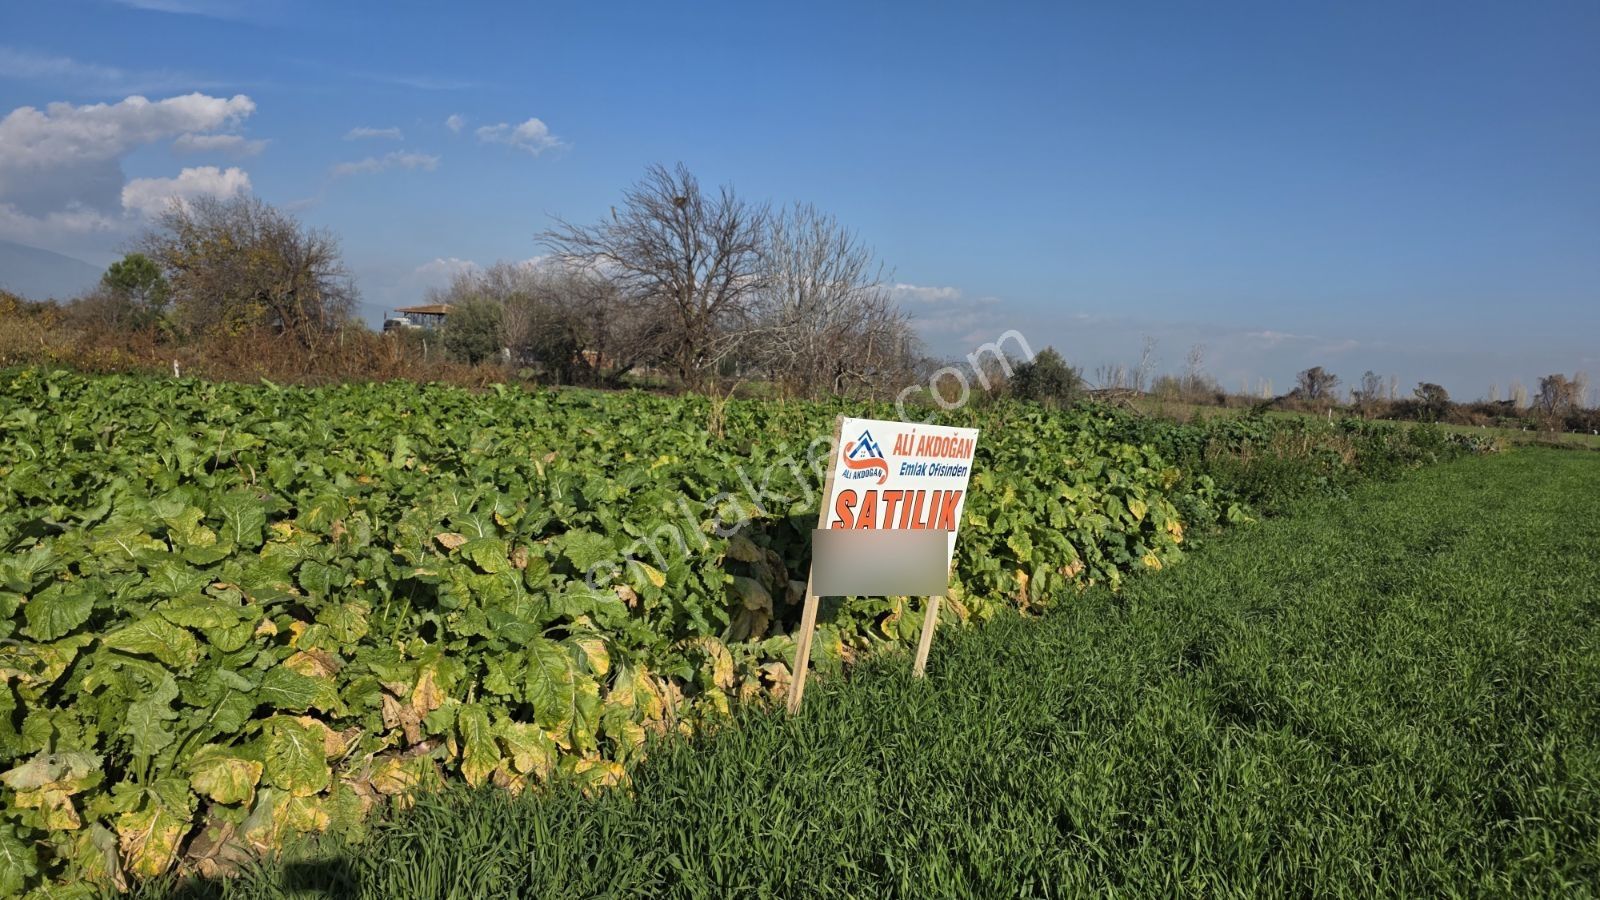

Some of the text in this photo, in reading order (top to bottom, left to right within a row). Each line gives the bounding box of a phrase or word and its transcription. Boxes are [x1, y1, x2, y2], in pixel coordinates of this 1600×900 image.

[893, 428, 973, 459] ALİ AKDOĞAN
[899, 462, 967, 477] Emlak Ofisinden
[832, 489, 962, 531] SATILIK
